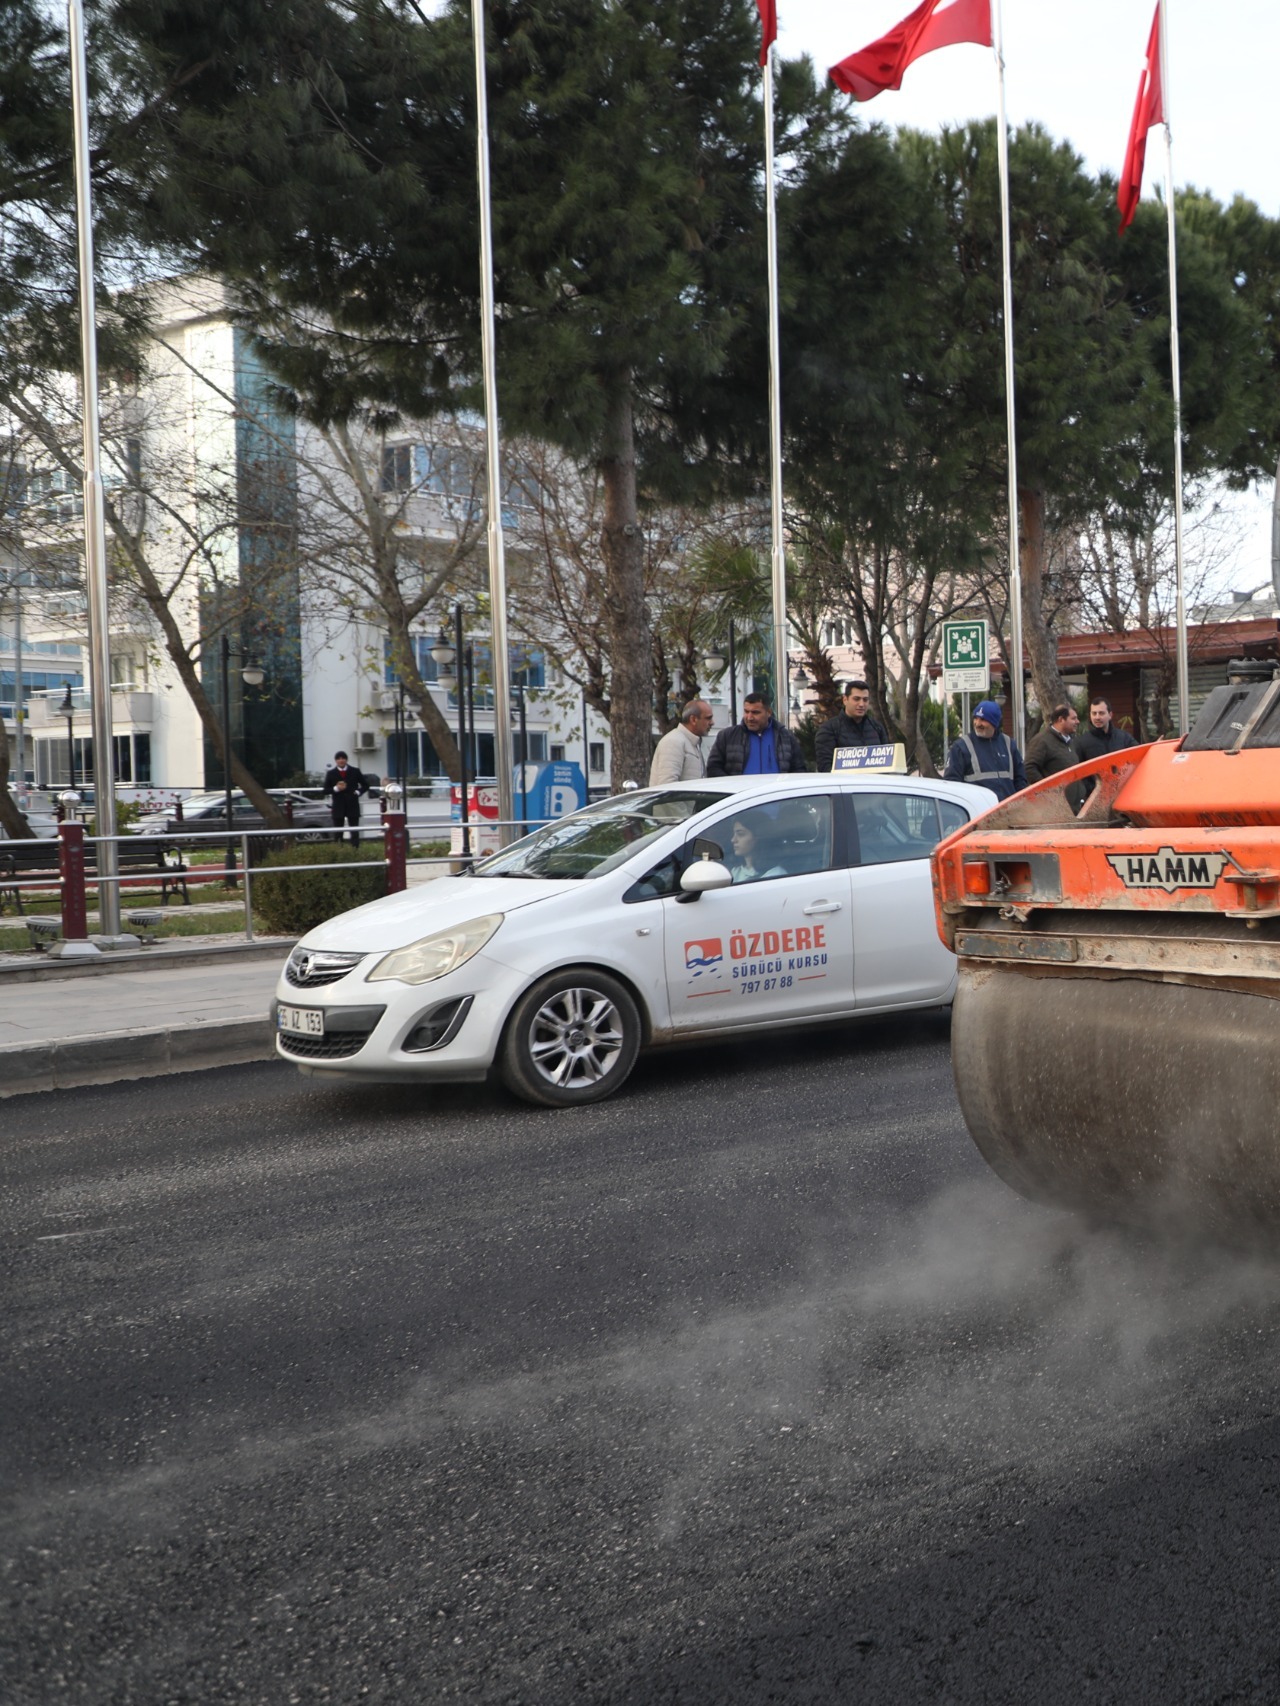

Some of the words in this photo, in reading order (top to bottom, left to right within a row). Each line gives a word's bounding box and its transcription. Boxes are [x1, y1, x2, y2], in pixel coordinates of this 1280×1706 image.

[837, 747, 868, 759] SÜRÜCÜ
[871, 746, 894, 757] ADAYI
[842, 759, 860, 767] SINAV
[865, 757, 886, 765] ARACI
[1127, 857, 1210, 883] HAMM
[729, 925, 826, 960] ÖZDERE
[732, 957, 782, 979] SÜRÜCÜ
[788, 953, 828, 970] KURSU
[740, 980, 761, 995] 797
[762, 978, 778, 992] 87
[779, 976, 794, 989] 88
